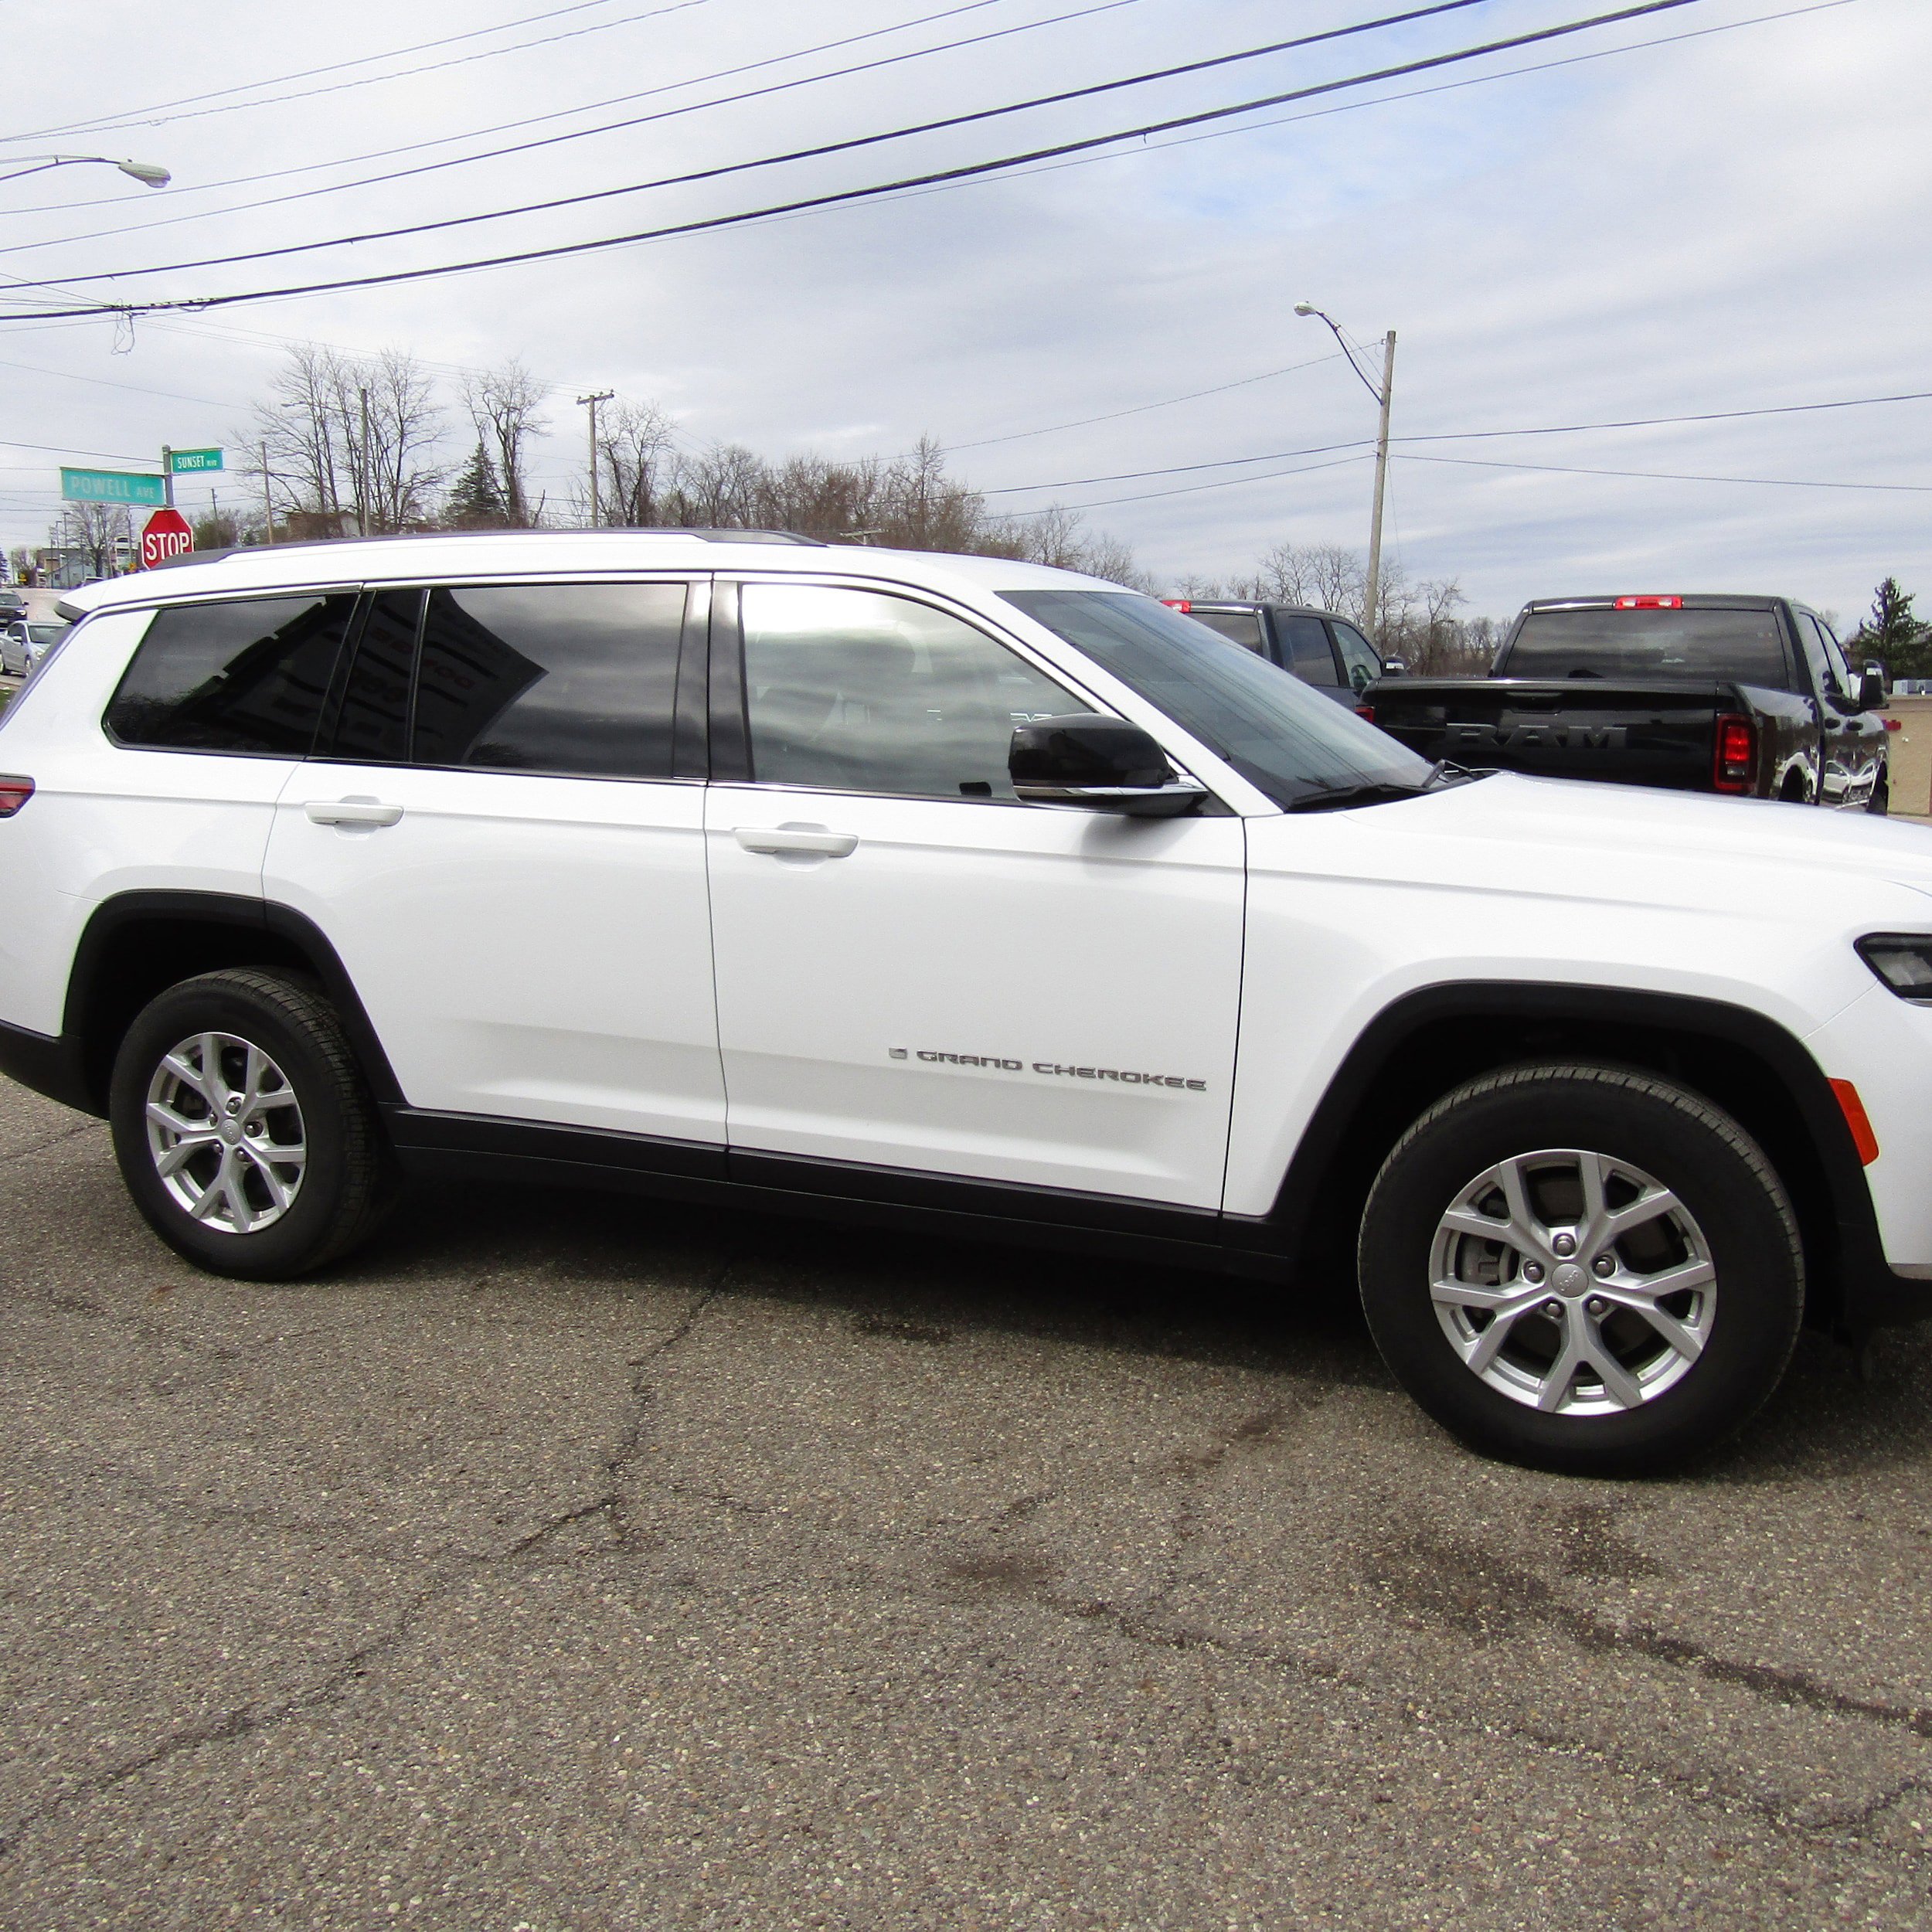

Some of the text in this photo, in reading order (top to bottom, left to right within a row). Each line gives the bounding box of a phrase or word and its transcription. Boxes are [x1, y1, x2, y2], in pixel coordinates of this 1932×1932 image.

[178, 455, 205, 469] SUNSET
[70, 476, 155, 499] POWELL AVE
[146, 532, 190, 560] STOP
[1445, 723, 1628, 748] RAM
[917, 1049, 1207, 1092] GRAND CHEROKEE
